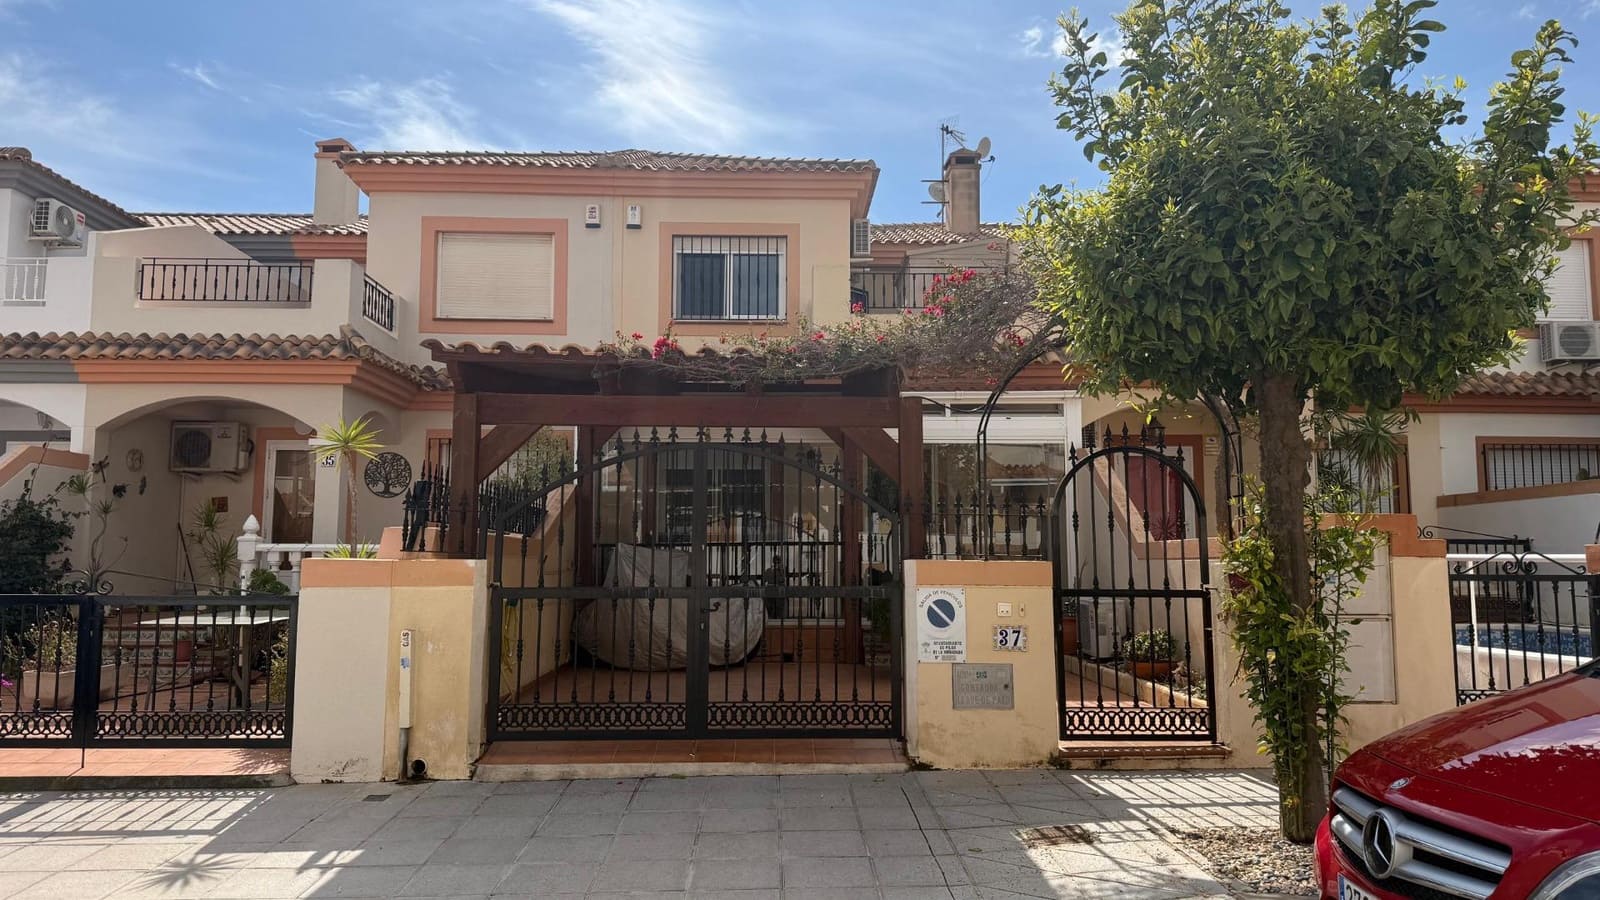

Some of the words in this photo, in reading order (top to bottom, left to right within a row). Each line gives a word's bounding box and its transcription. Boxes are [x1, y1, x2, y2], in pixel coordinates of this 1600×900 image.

[322, 455, 335, 465] 35
[918, 593, 932, 608] SALIDA
[999, 629, 1021, 647] 37
